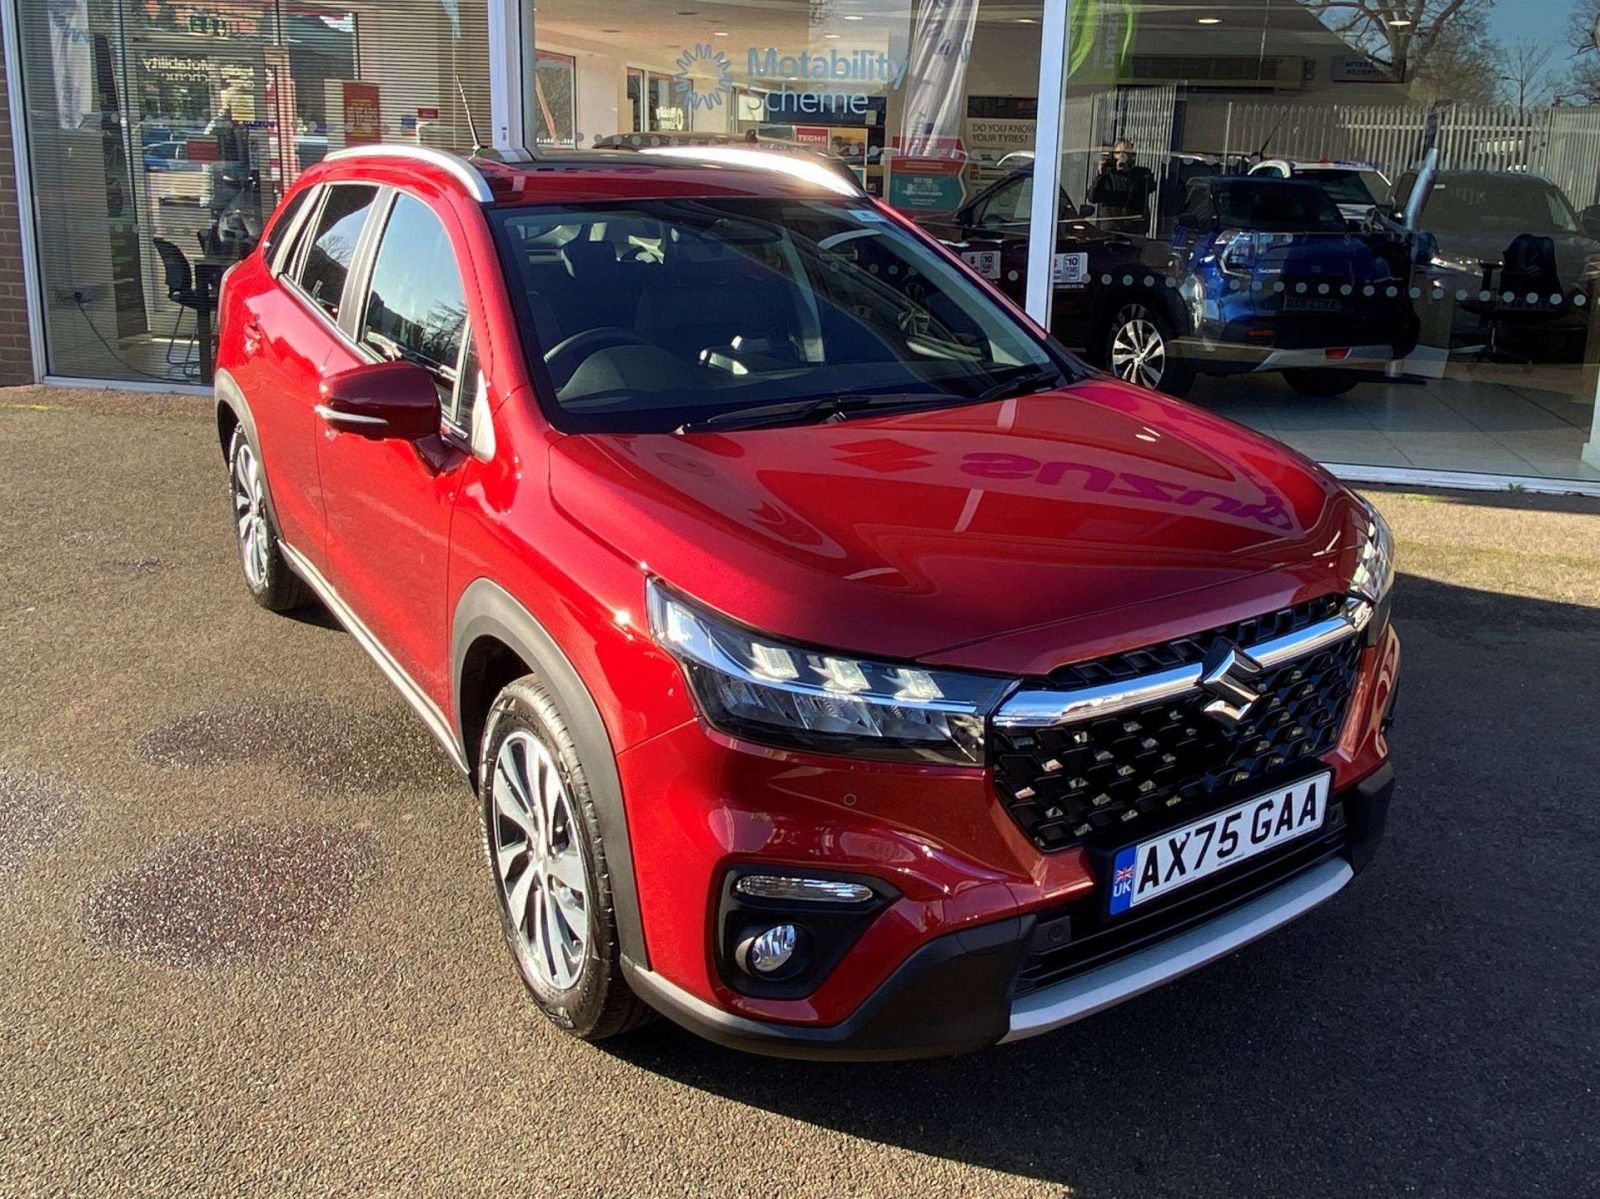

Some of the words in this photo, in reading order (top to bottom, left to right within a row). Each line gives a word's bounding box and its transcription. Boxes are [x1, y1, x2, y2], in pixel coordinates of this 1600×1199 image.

[747, 47, 909, 90] Motability
[747, 82, 869, 114] Scheme
[972, 123, 987, 133] DO
[988, 123, 1007, 133] YOU
[972, 133, 997, 142] YOUR
[1137, 811, 1243, 894] AX75
[1250, 783, 1317, 845] GAA
[1113, 880, 1131, 898] UK
